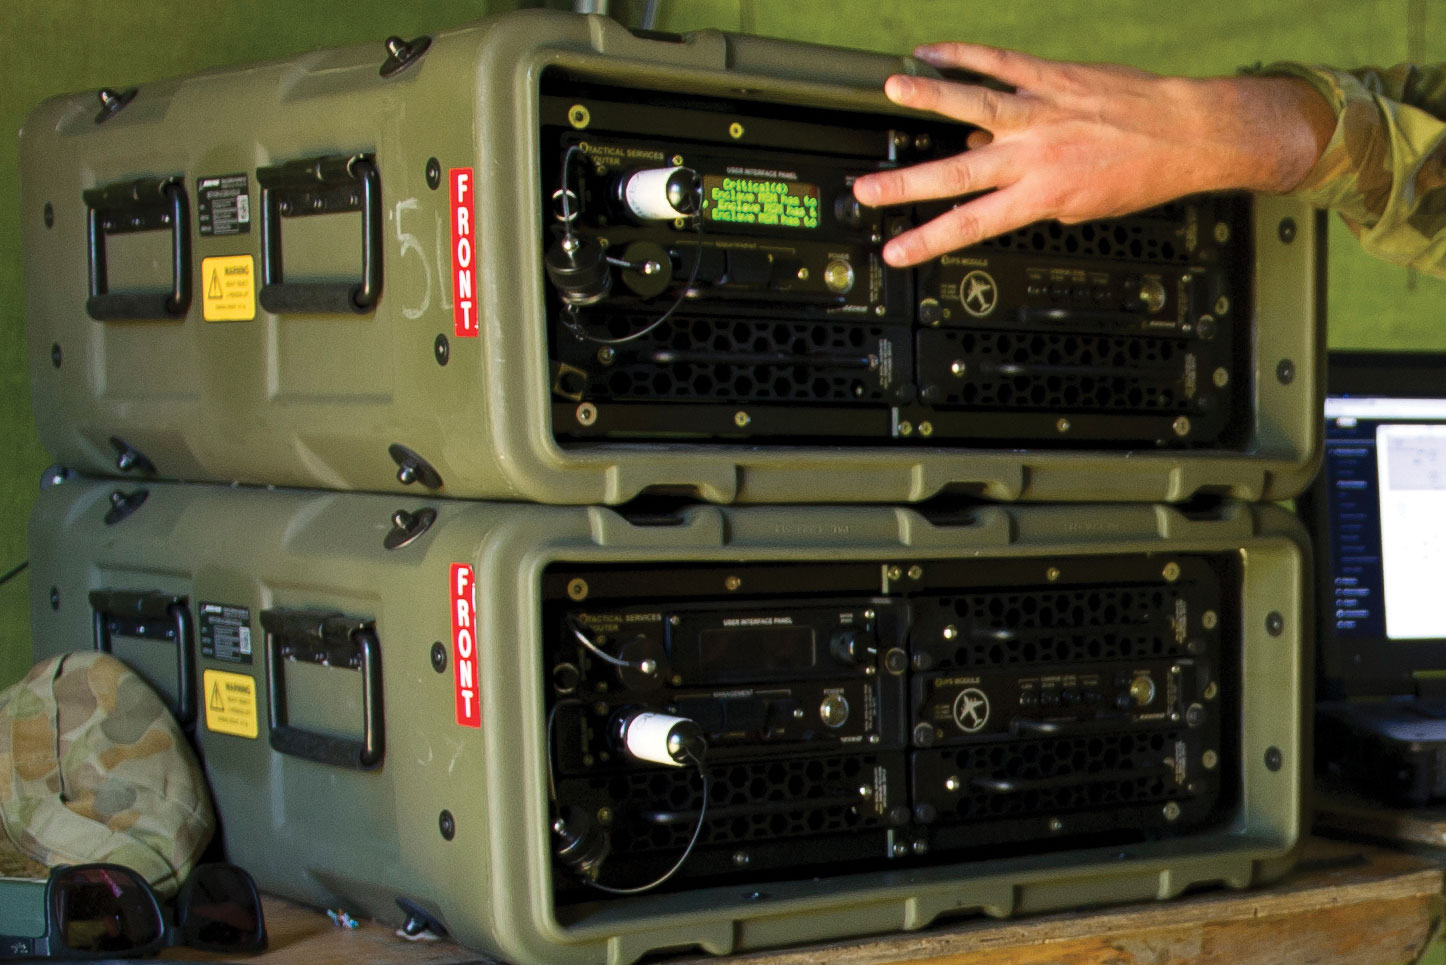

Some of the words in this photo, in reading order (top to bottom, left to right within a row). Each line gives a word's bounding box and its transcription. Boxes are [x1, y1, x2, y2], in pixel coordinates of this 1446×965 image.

[588, 145, 625, 157] TACTICAL
[626, 149, 665, 161] SERVICES
[457, 173, 472, 330] FRONT
[587, 613, 625, 623] TACTICAL
[625, 612, 662, 622] SERVICES
[723, 618, 740, 627] USER
[740, 617, 773, 626] INTERFACE
[773, 616, 793, 625] PANEL
[457, 567, 474, 718] FRONT
